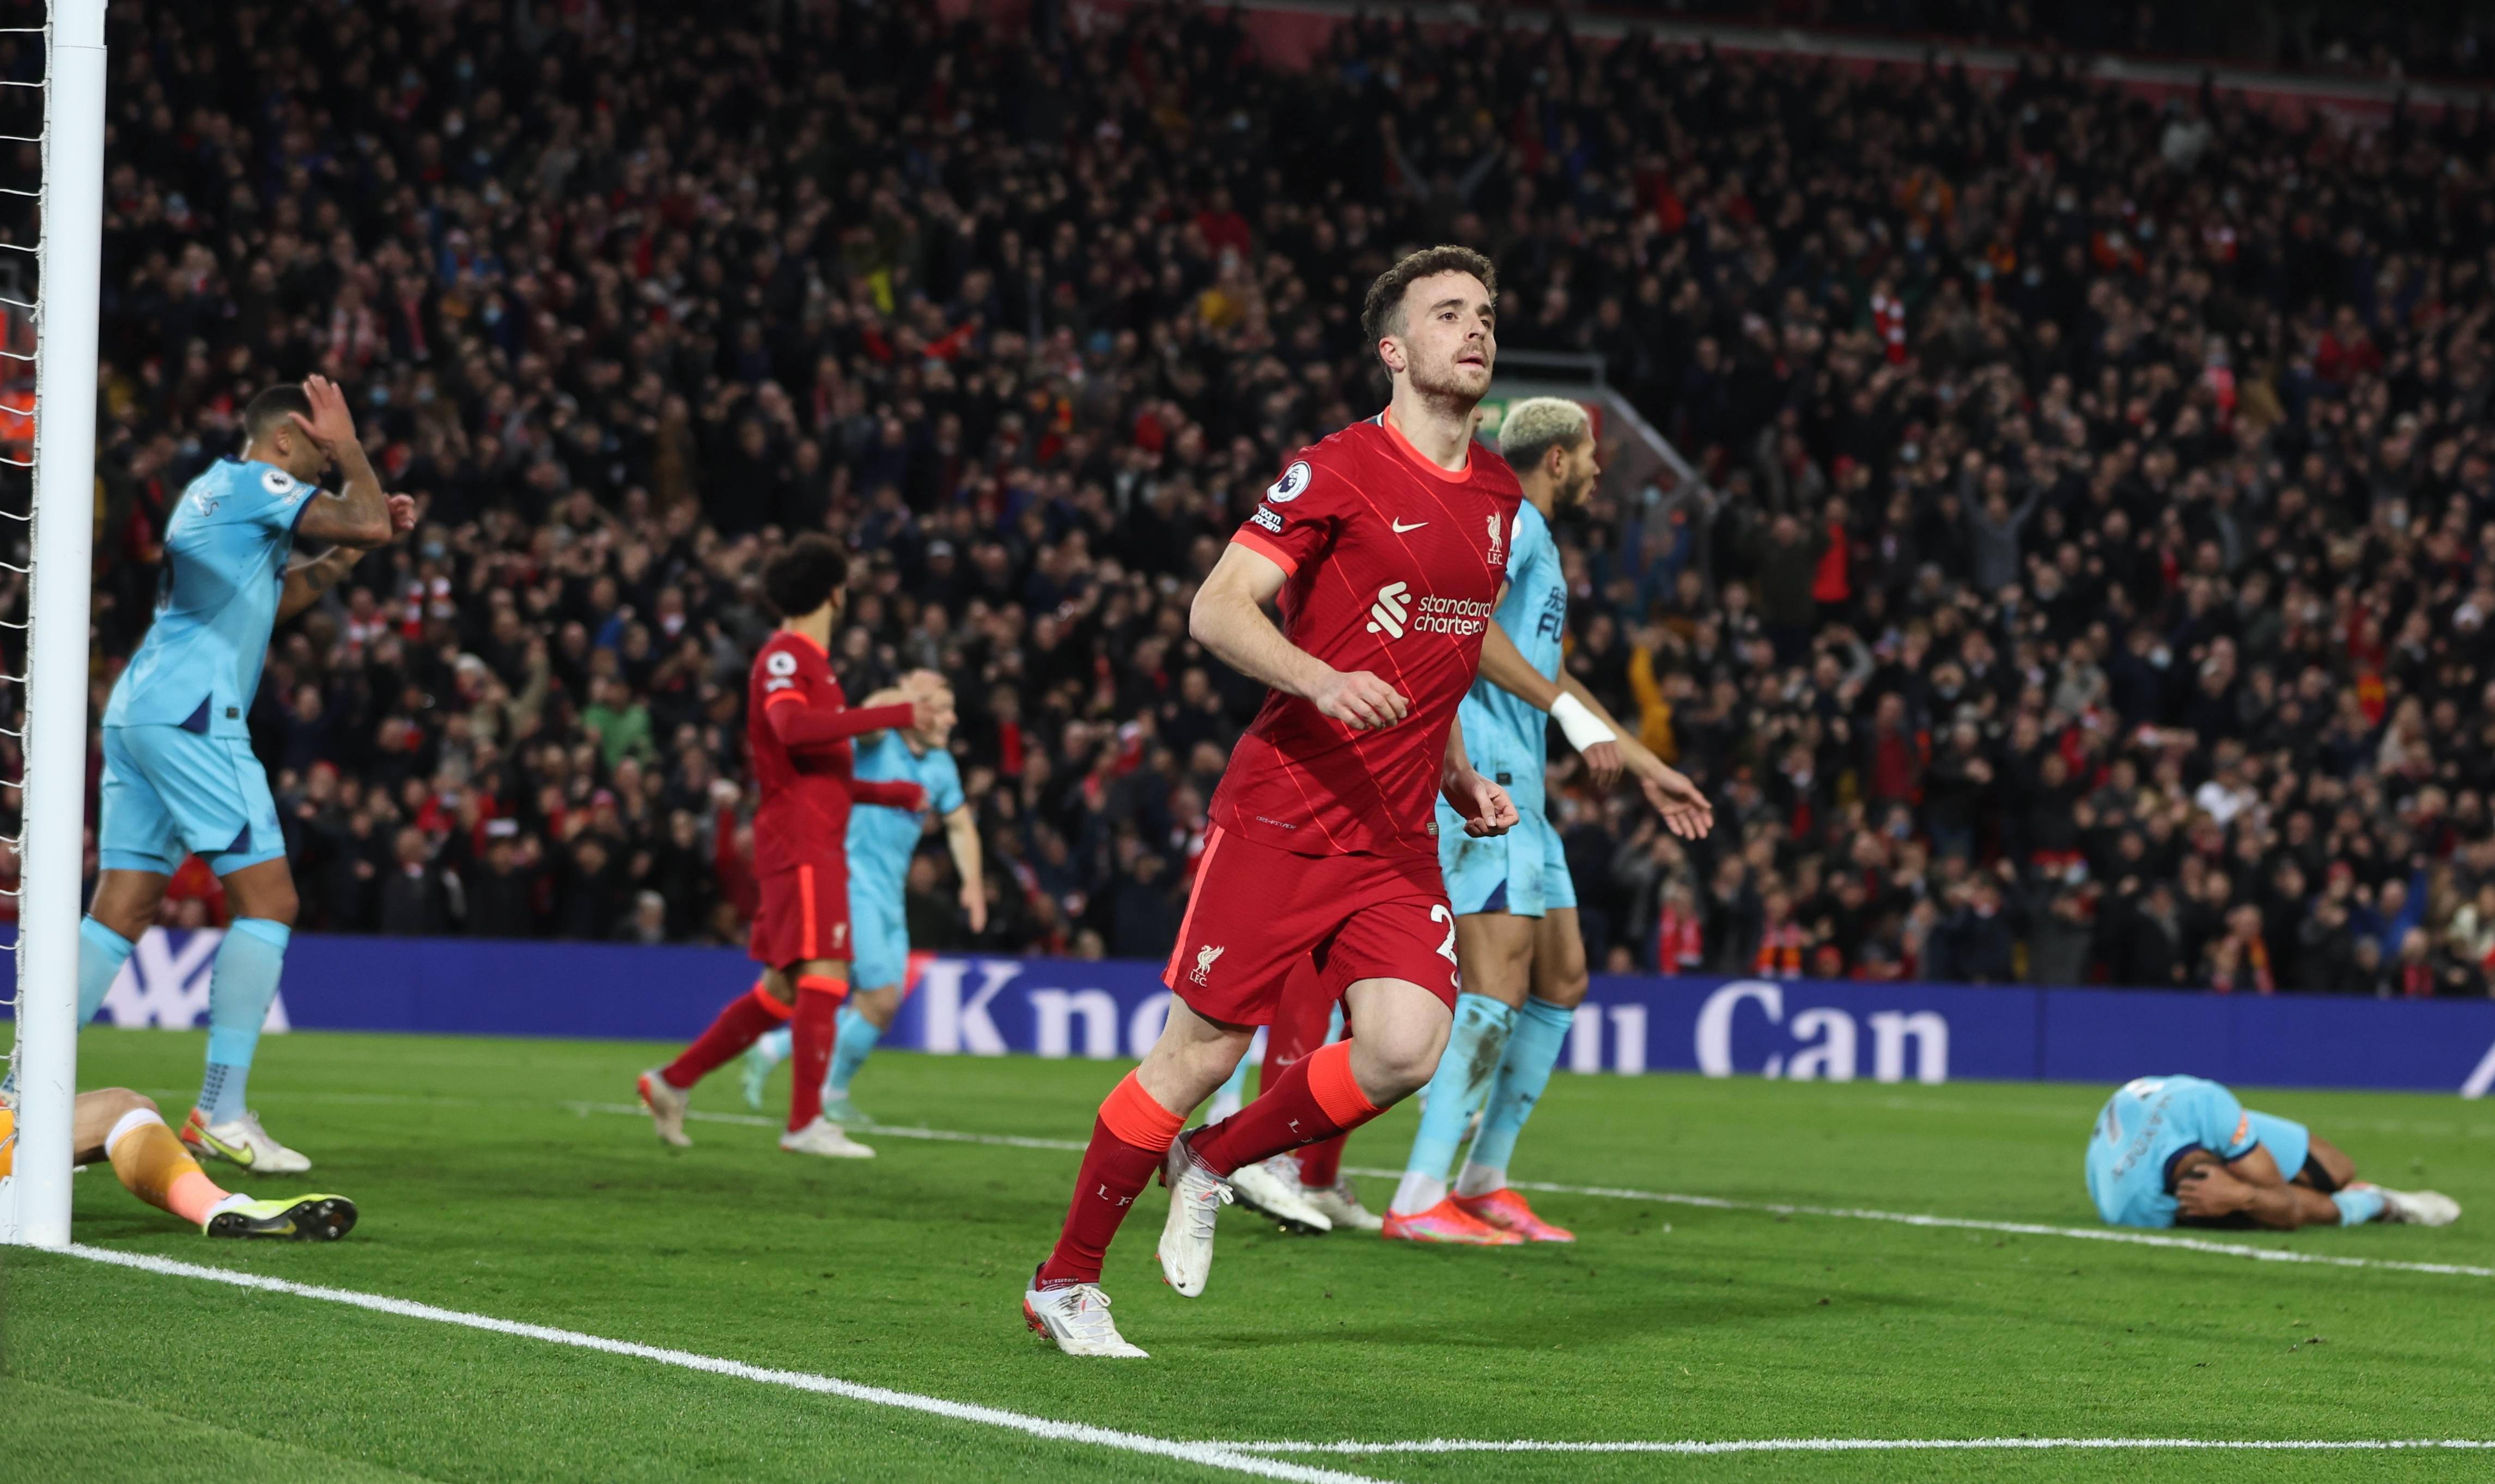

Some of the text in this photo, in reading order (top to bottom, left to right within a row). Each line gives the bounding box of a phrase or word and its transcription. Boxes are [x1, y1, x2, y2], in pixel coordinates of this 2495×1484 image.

[1258, 507, 1281, 525] room
[1418, 593, 1493, 618] standard
[1694, 981, 1949, 1084] Can
